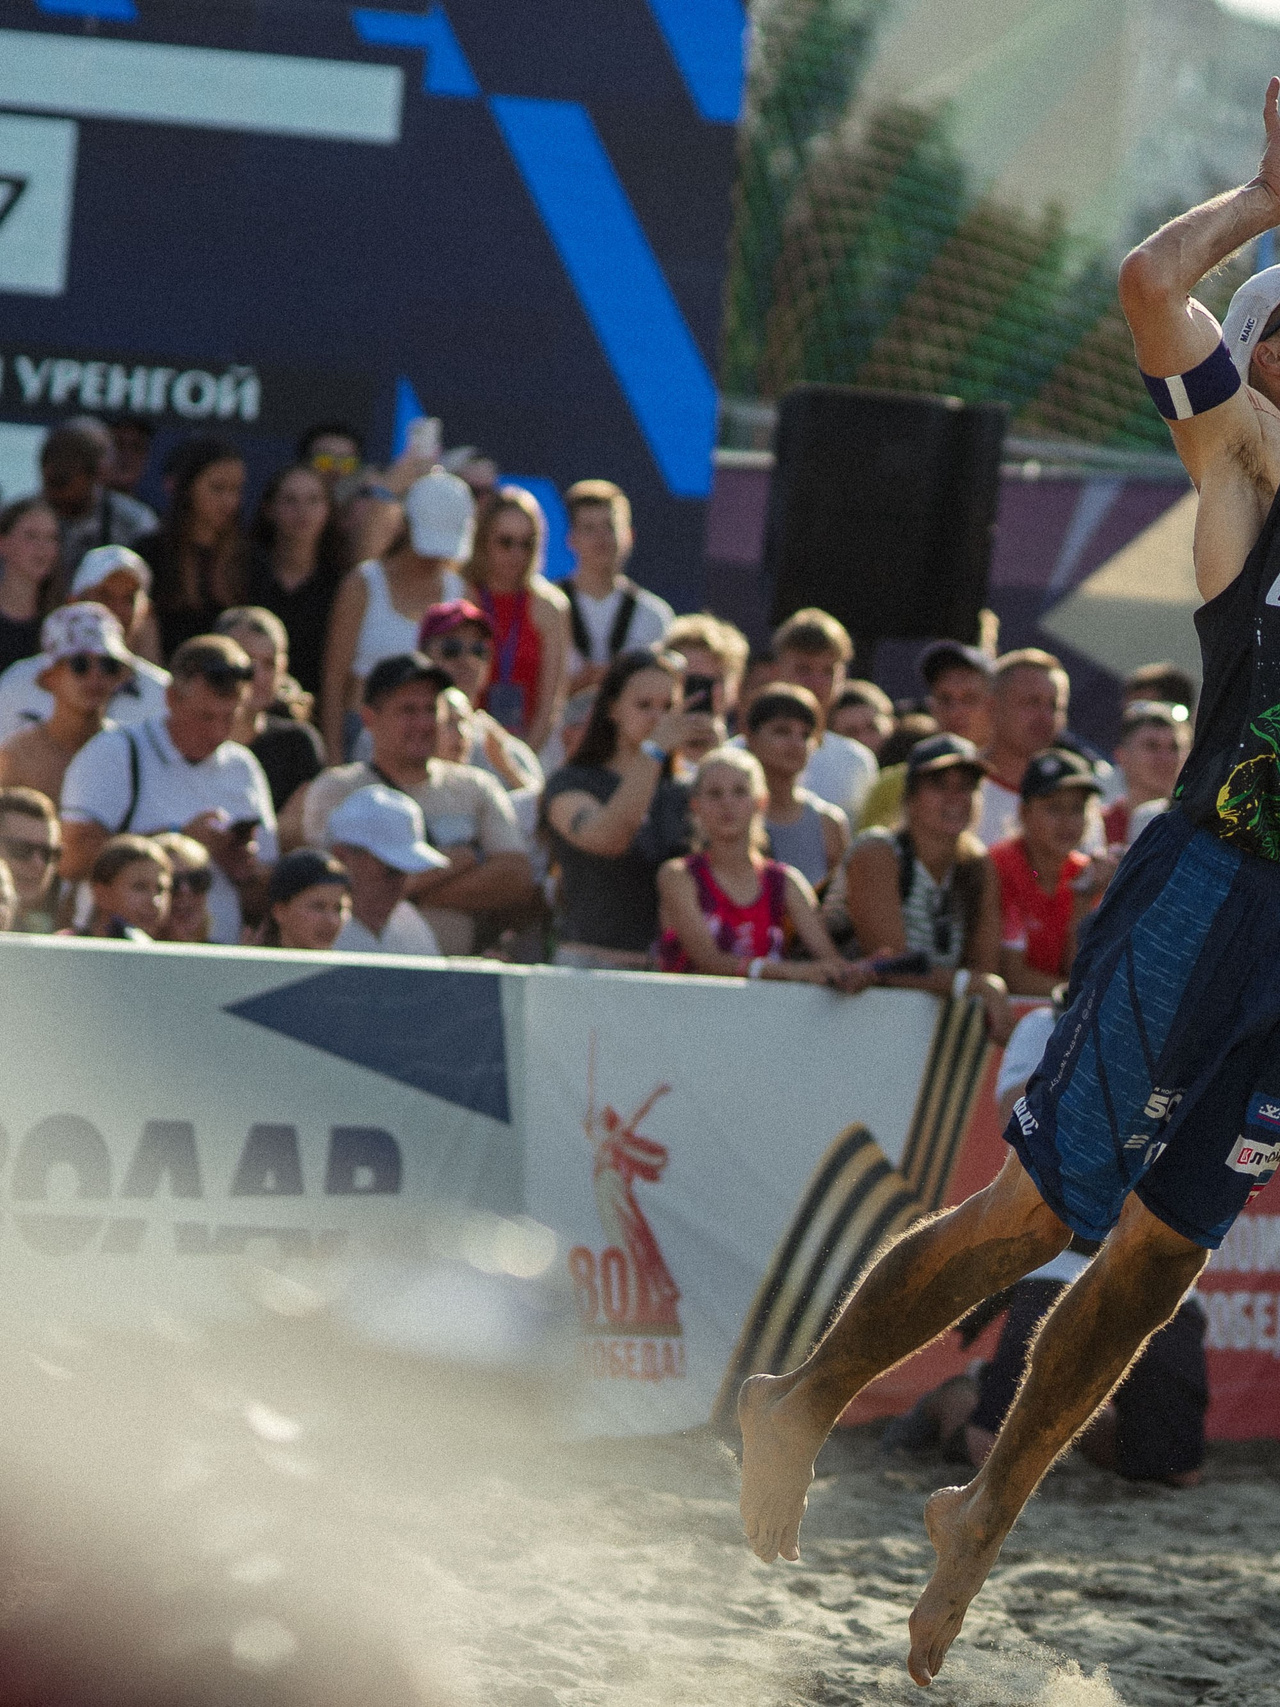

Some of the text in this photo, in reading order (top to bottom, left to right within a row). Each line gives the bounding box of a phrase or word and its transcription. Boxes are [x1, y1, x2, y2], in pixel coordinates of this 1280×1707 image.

[1240, 318, 1255, 342] МАКС
[14, 354, 261, 422] УРЕНГОЙ
[569, 1246, 627, 1324] 80
